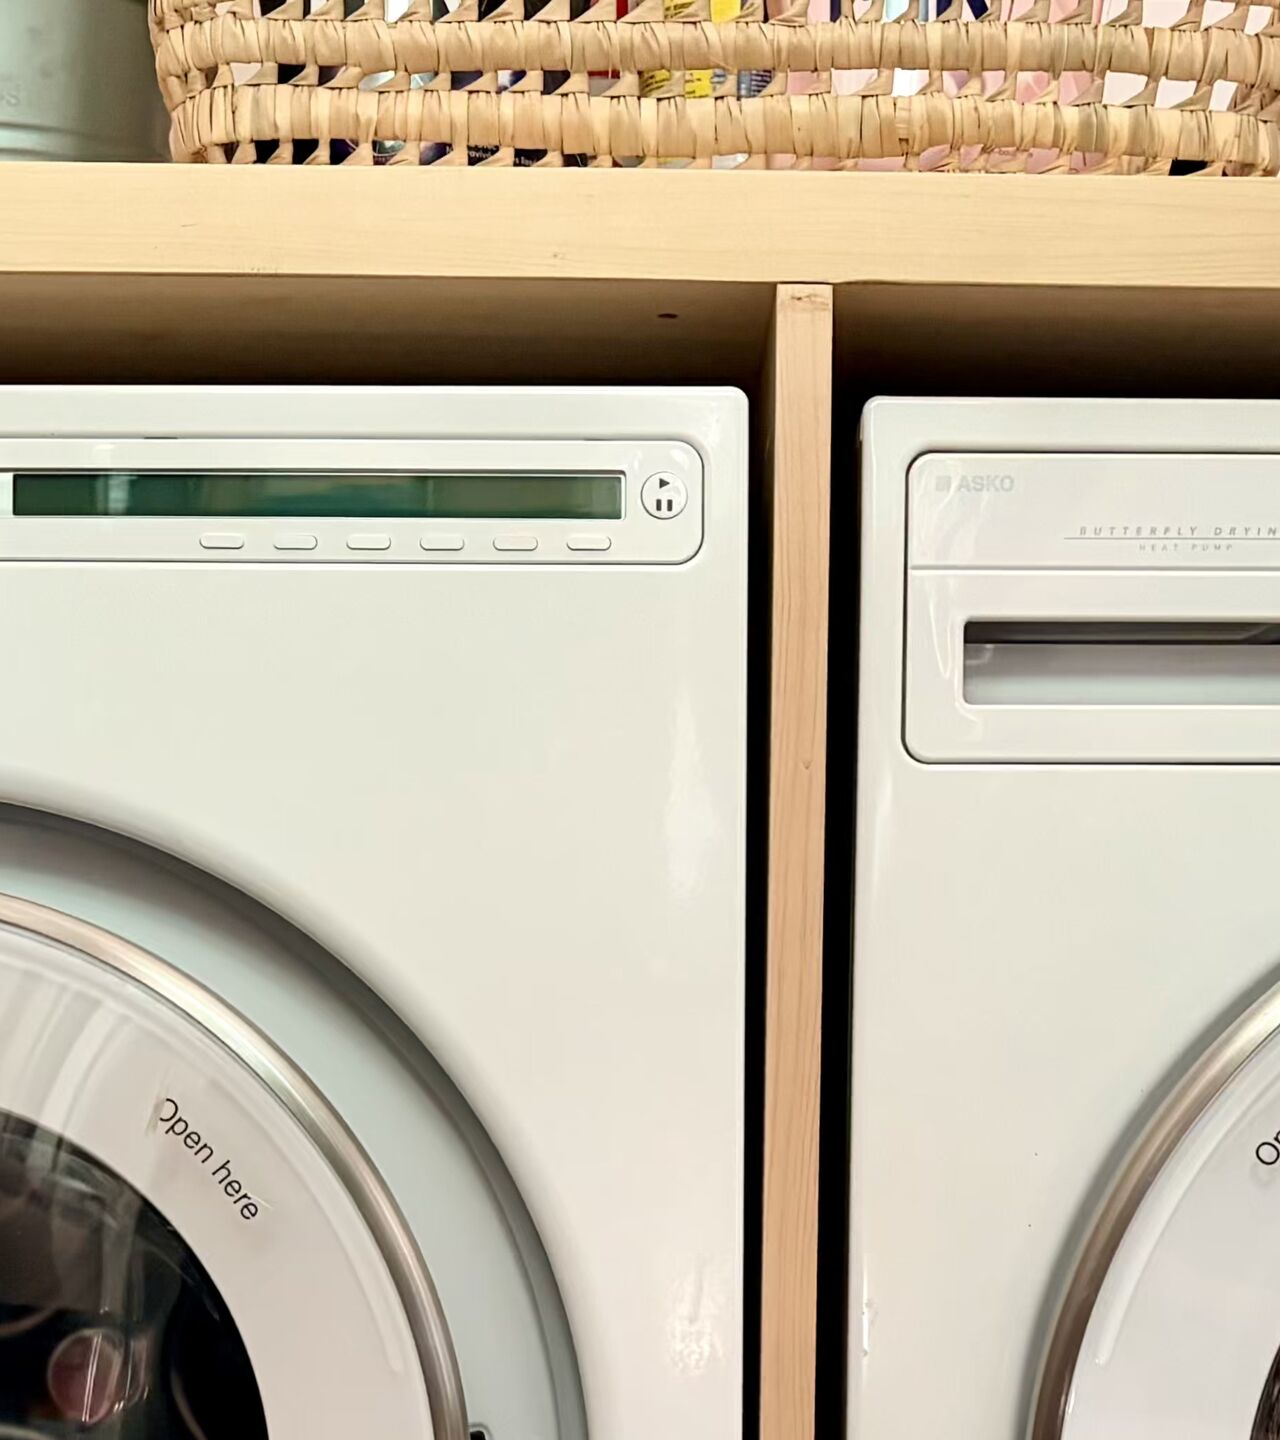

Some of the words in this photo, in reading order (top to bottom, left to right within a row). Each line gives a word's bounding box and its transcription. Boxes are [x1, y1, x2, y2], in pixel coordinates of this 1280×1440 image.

[959, 474, 1015, 492] ASKO
[1079, 526, 1198, 536] BUTTERFLY
[211, 1159, 259, 1220] here
